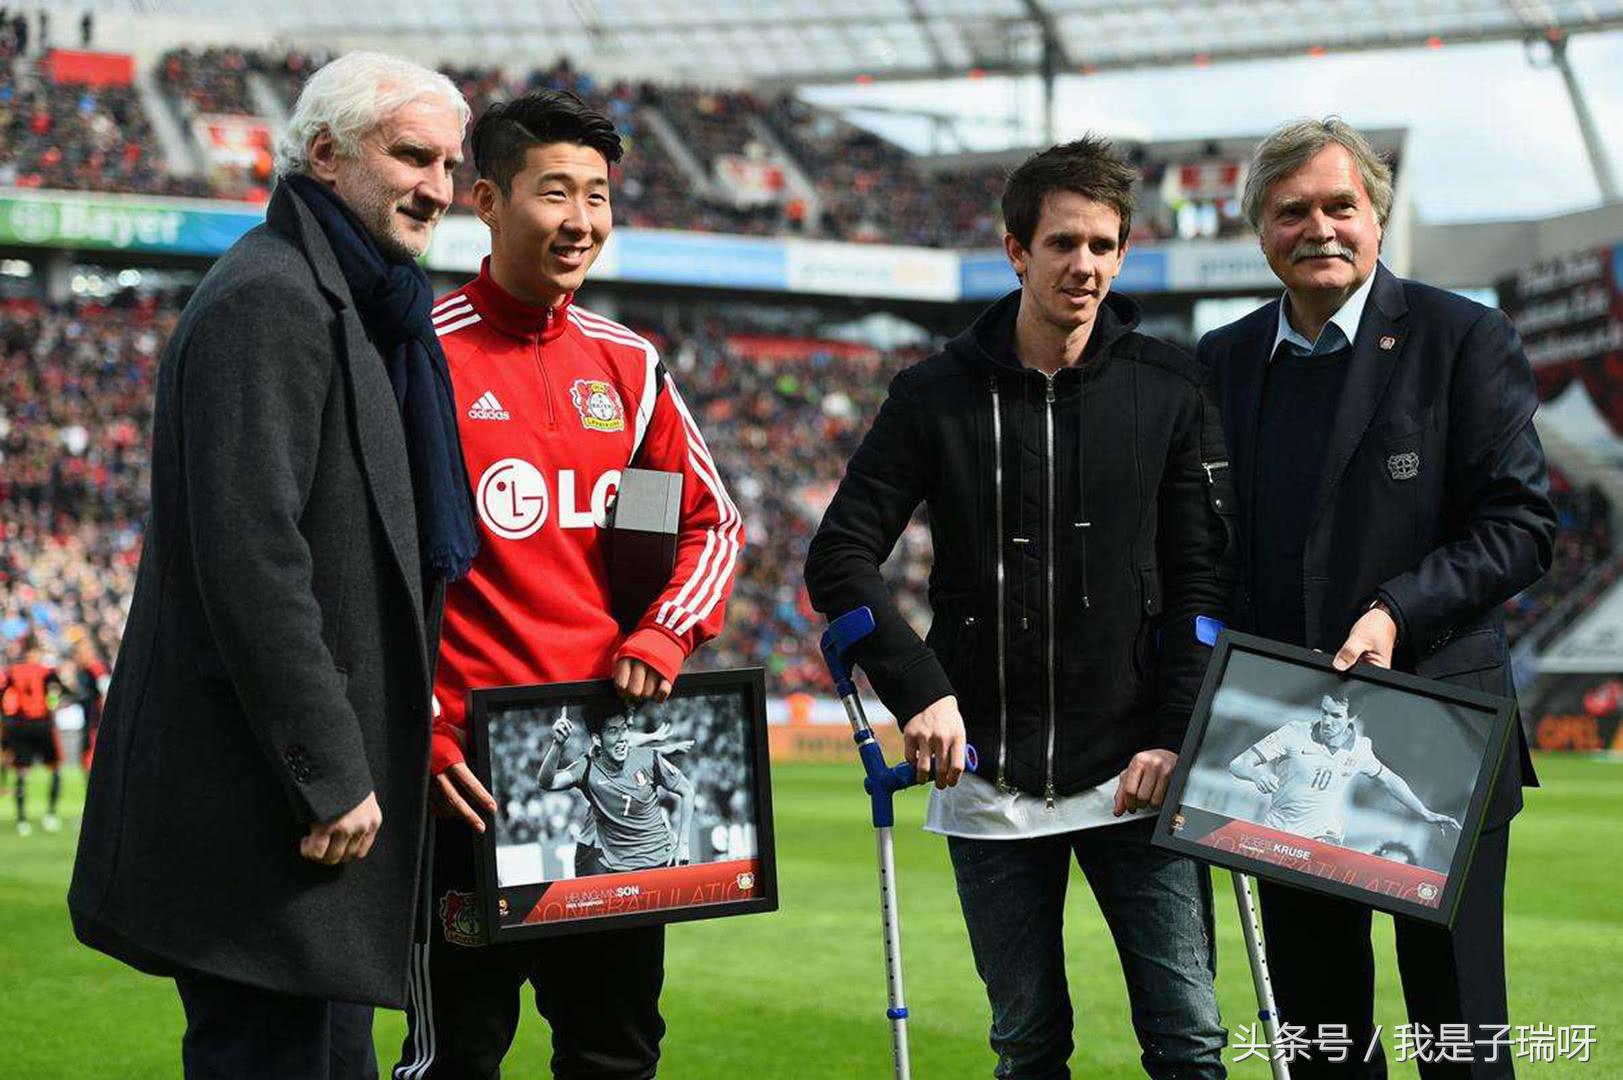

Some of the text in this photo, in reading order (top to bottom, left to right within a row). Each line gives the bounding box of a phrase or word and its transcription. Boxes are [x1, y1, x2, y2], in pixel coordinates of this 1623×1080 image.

[60, 201, 184, 248] Bayer
[468, 409, 510, 420] adidas
[1311, 767, 1332, 791] 10
[622, 794, 632, 817] 7
[1273, 843, 1312, 860] KRUSE
[616, 885, 640, 898] SON
